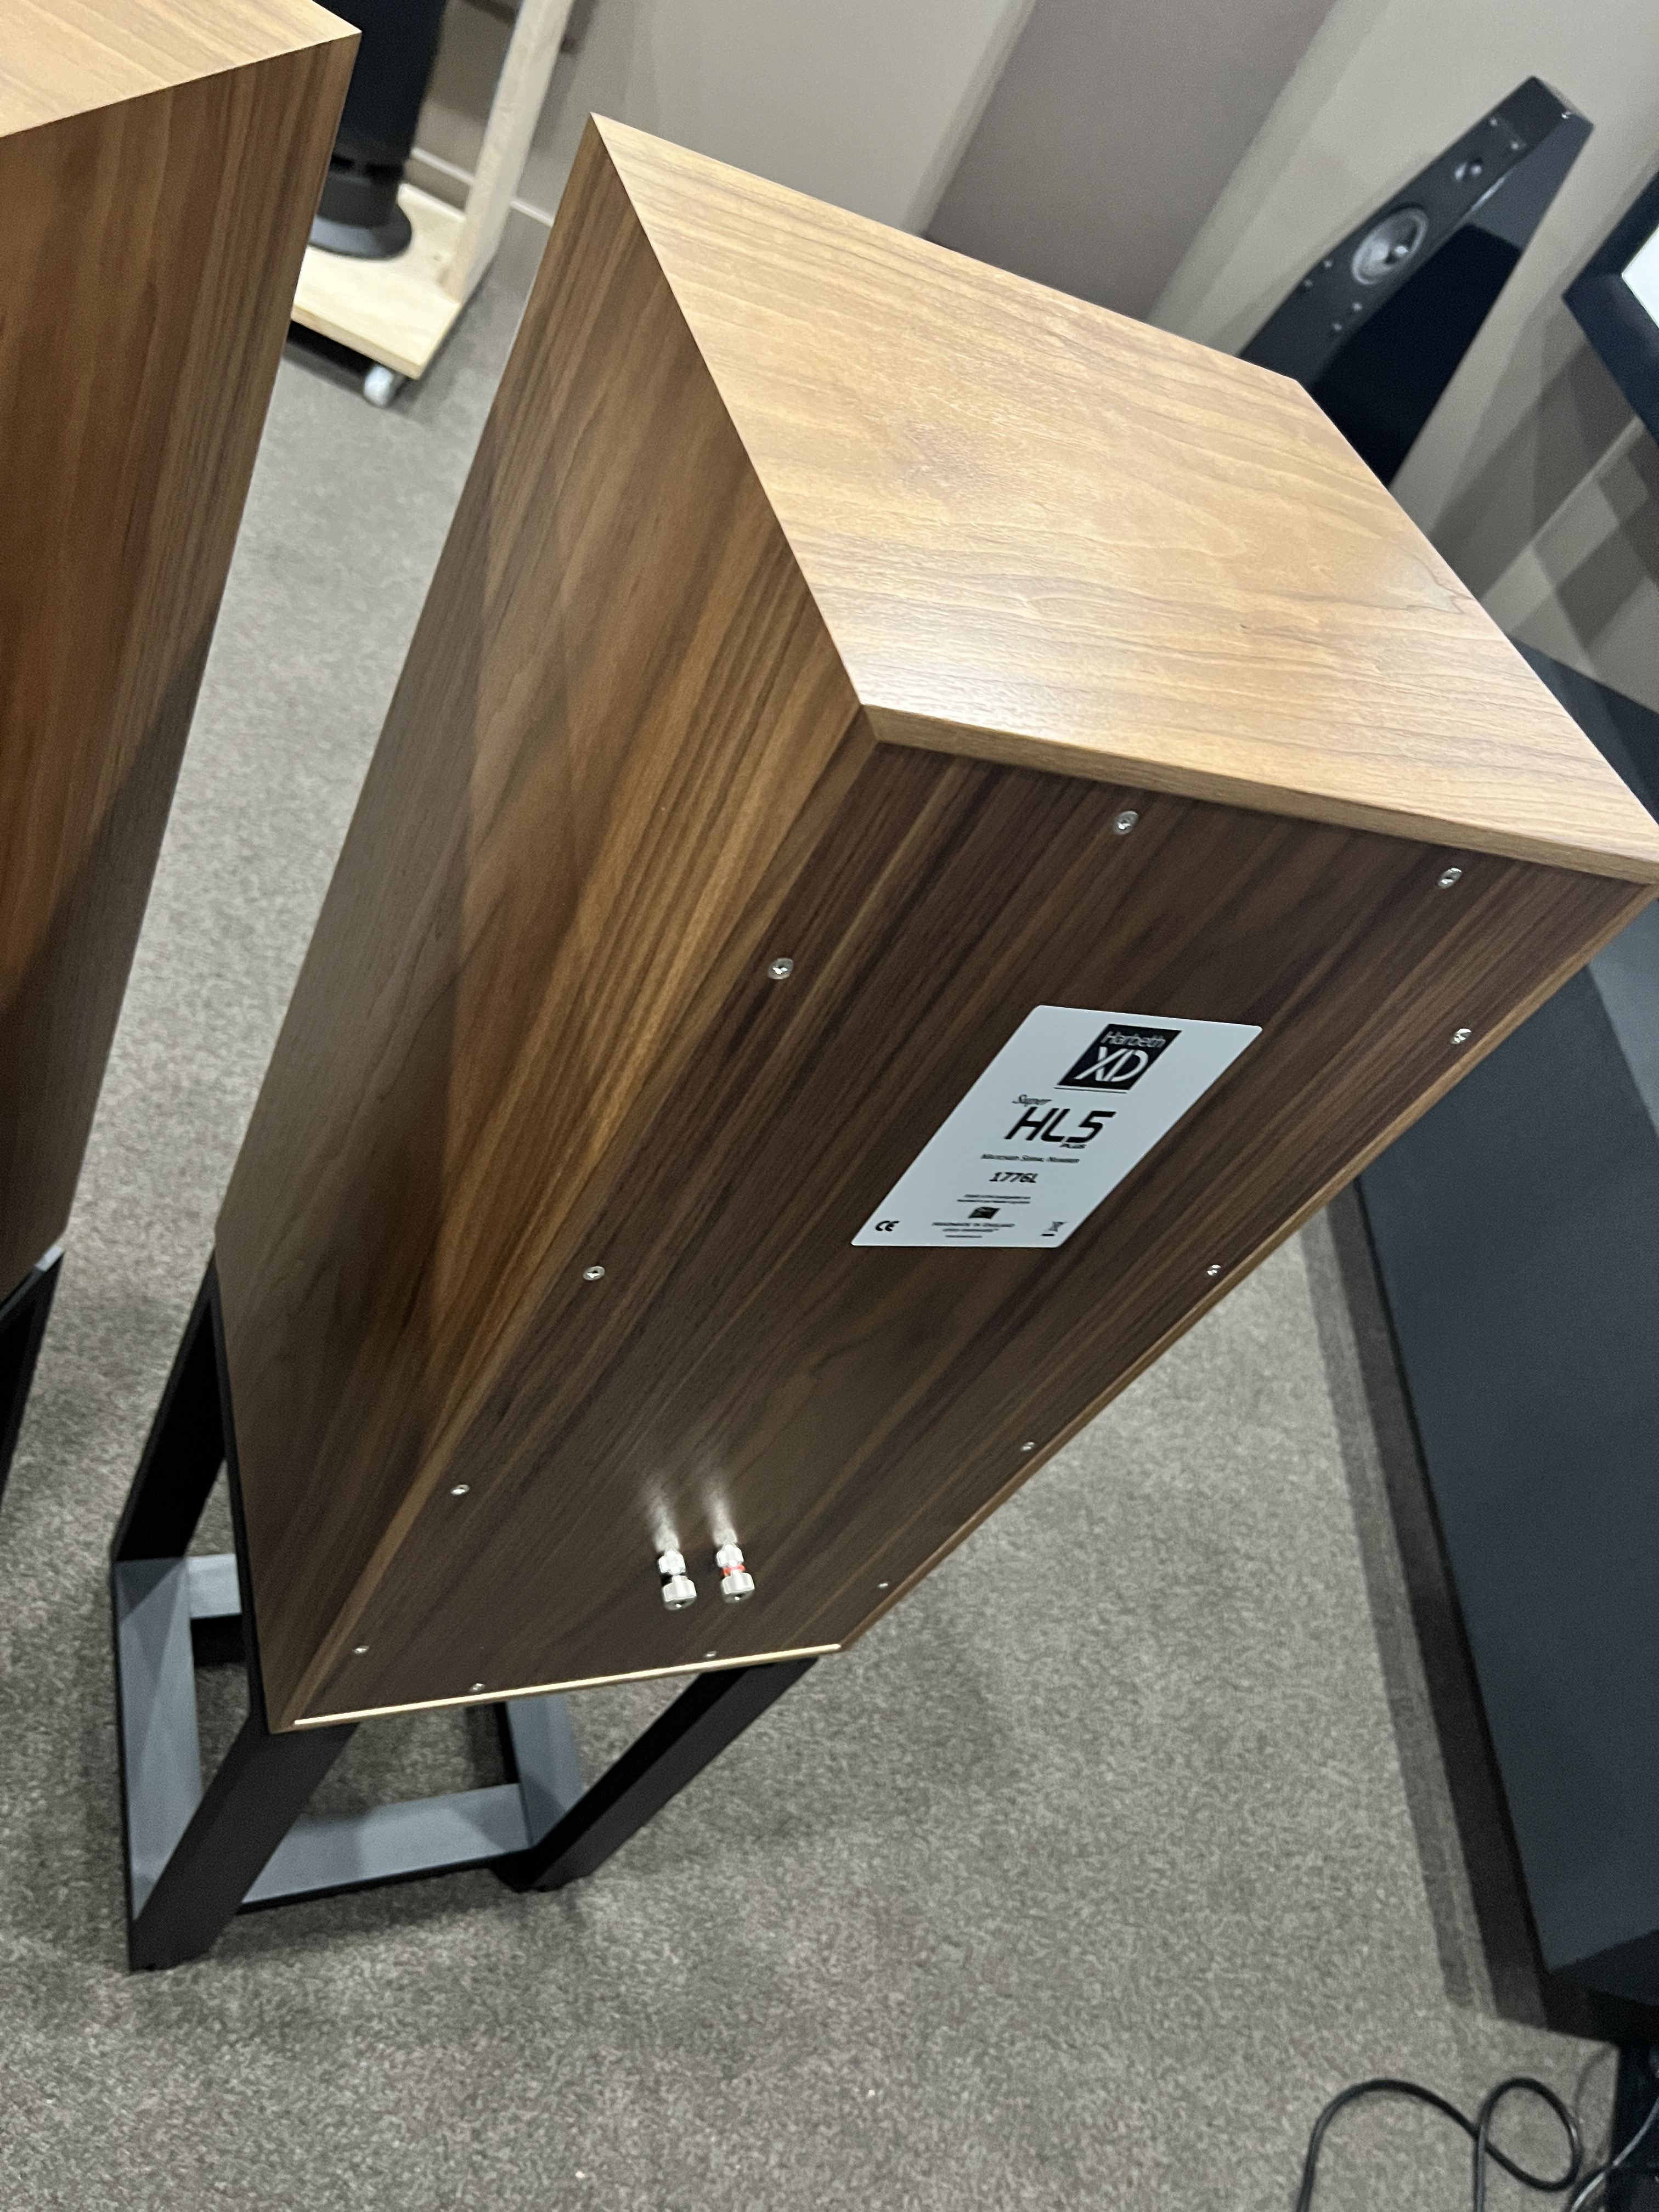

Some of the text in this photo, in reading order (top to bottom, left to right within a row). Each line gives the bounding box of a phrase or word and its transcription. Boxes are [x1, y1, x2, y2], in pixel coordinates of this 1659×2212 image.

[1101, 1031, 1166, 1048] Harbeth
[1073, 1046, 1149, 1082] XD
[1003, 1106, 1116, 1143] HL5
